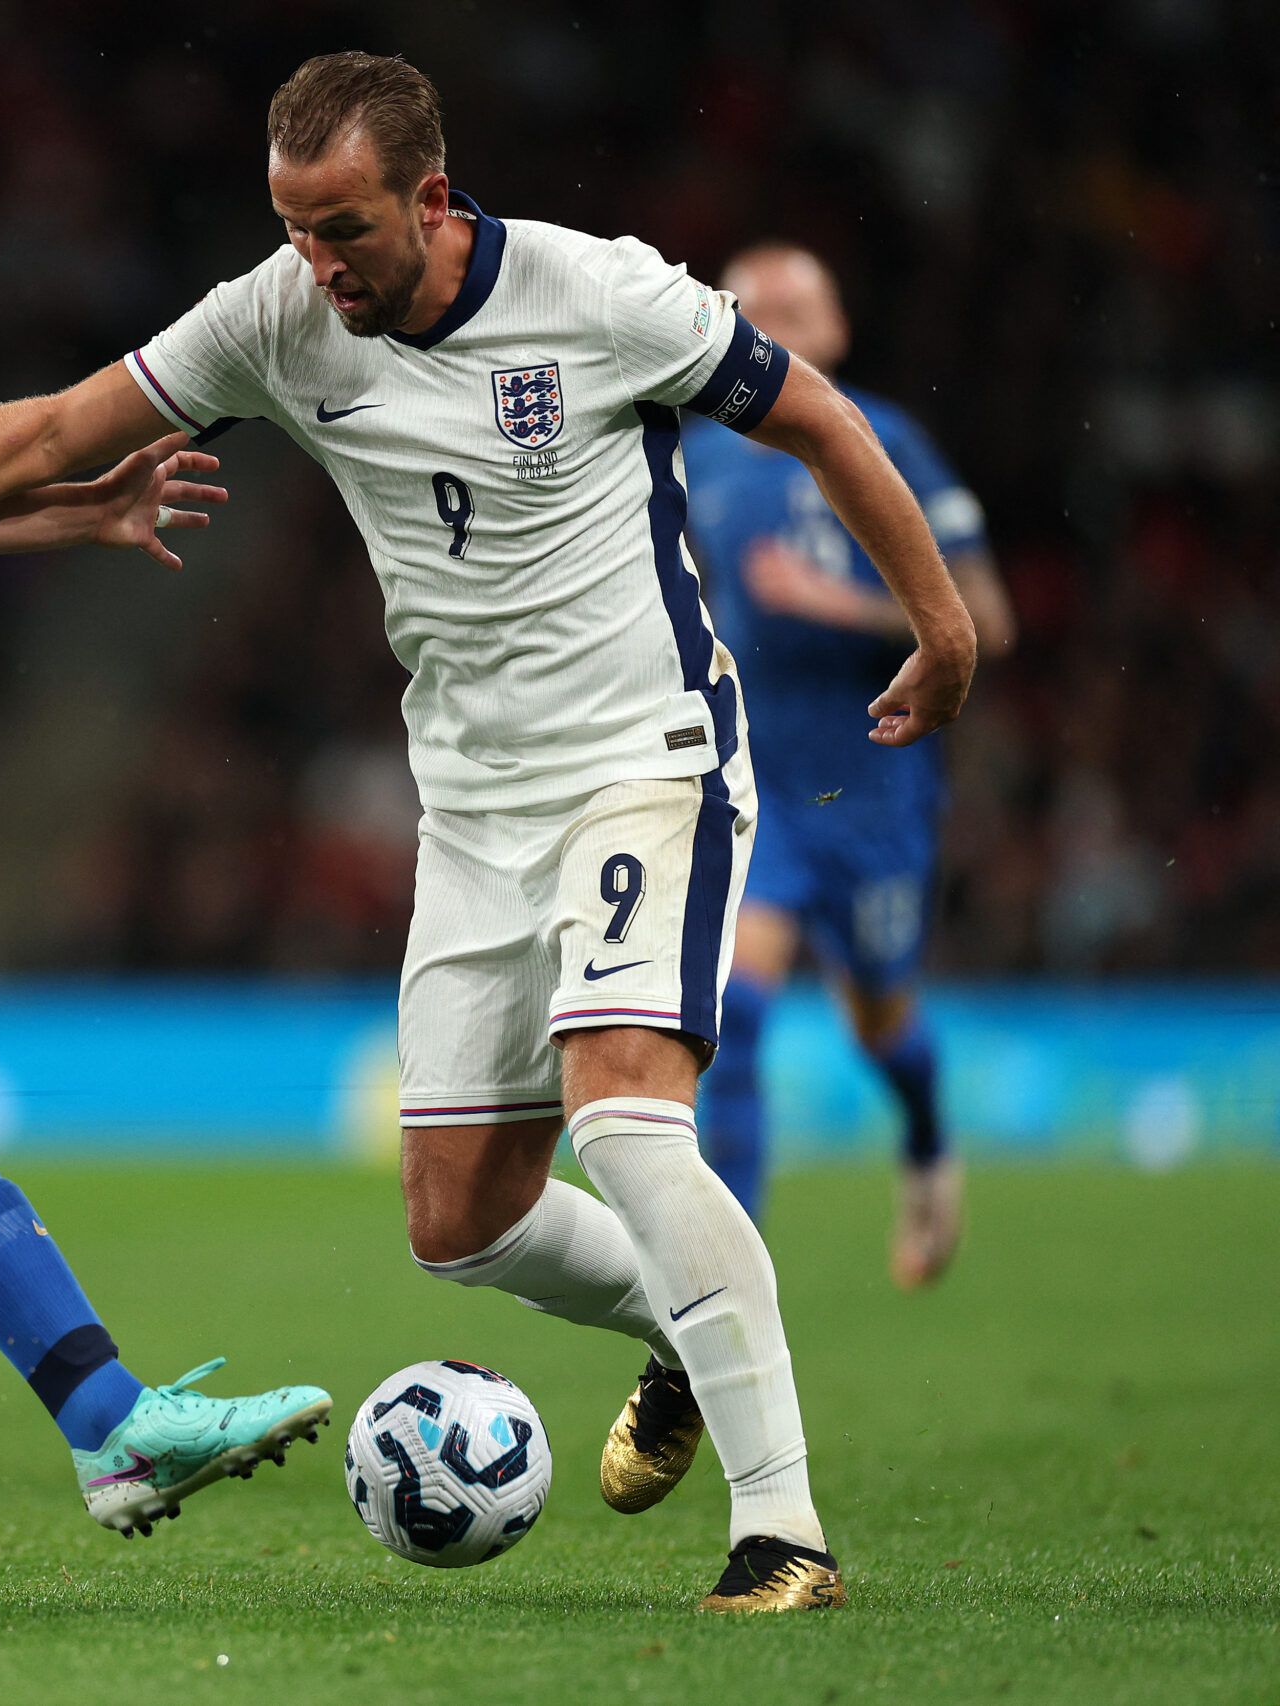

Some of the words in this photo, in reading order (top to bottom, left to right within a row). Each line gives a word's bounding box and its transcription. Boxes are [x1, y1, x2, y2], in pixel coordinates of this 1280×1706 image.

[512, 451, 559, 466] FINLAND
[432, 471, 475, 560] 9
[600, 852, 646, 944] 9
